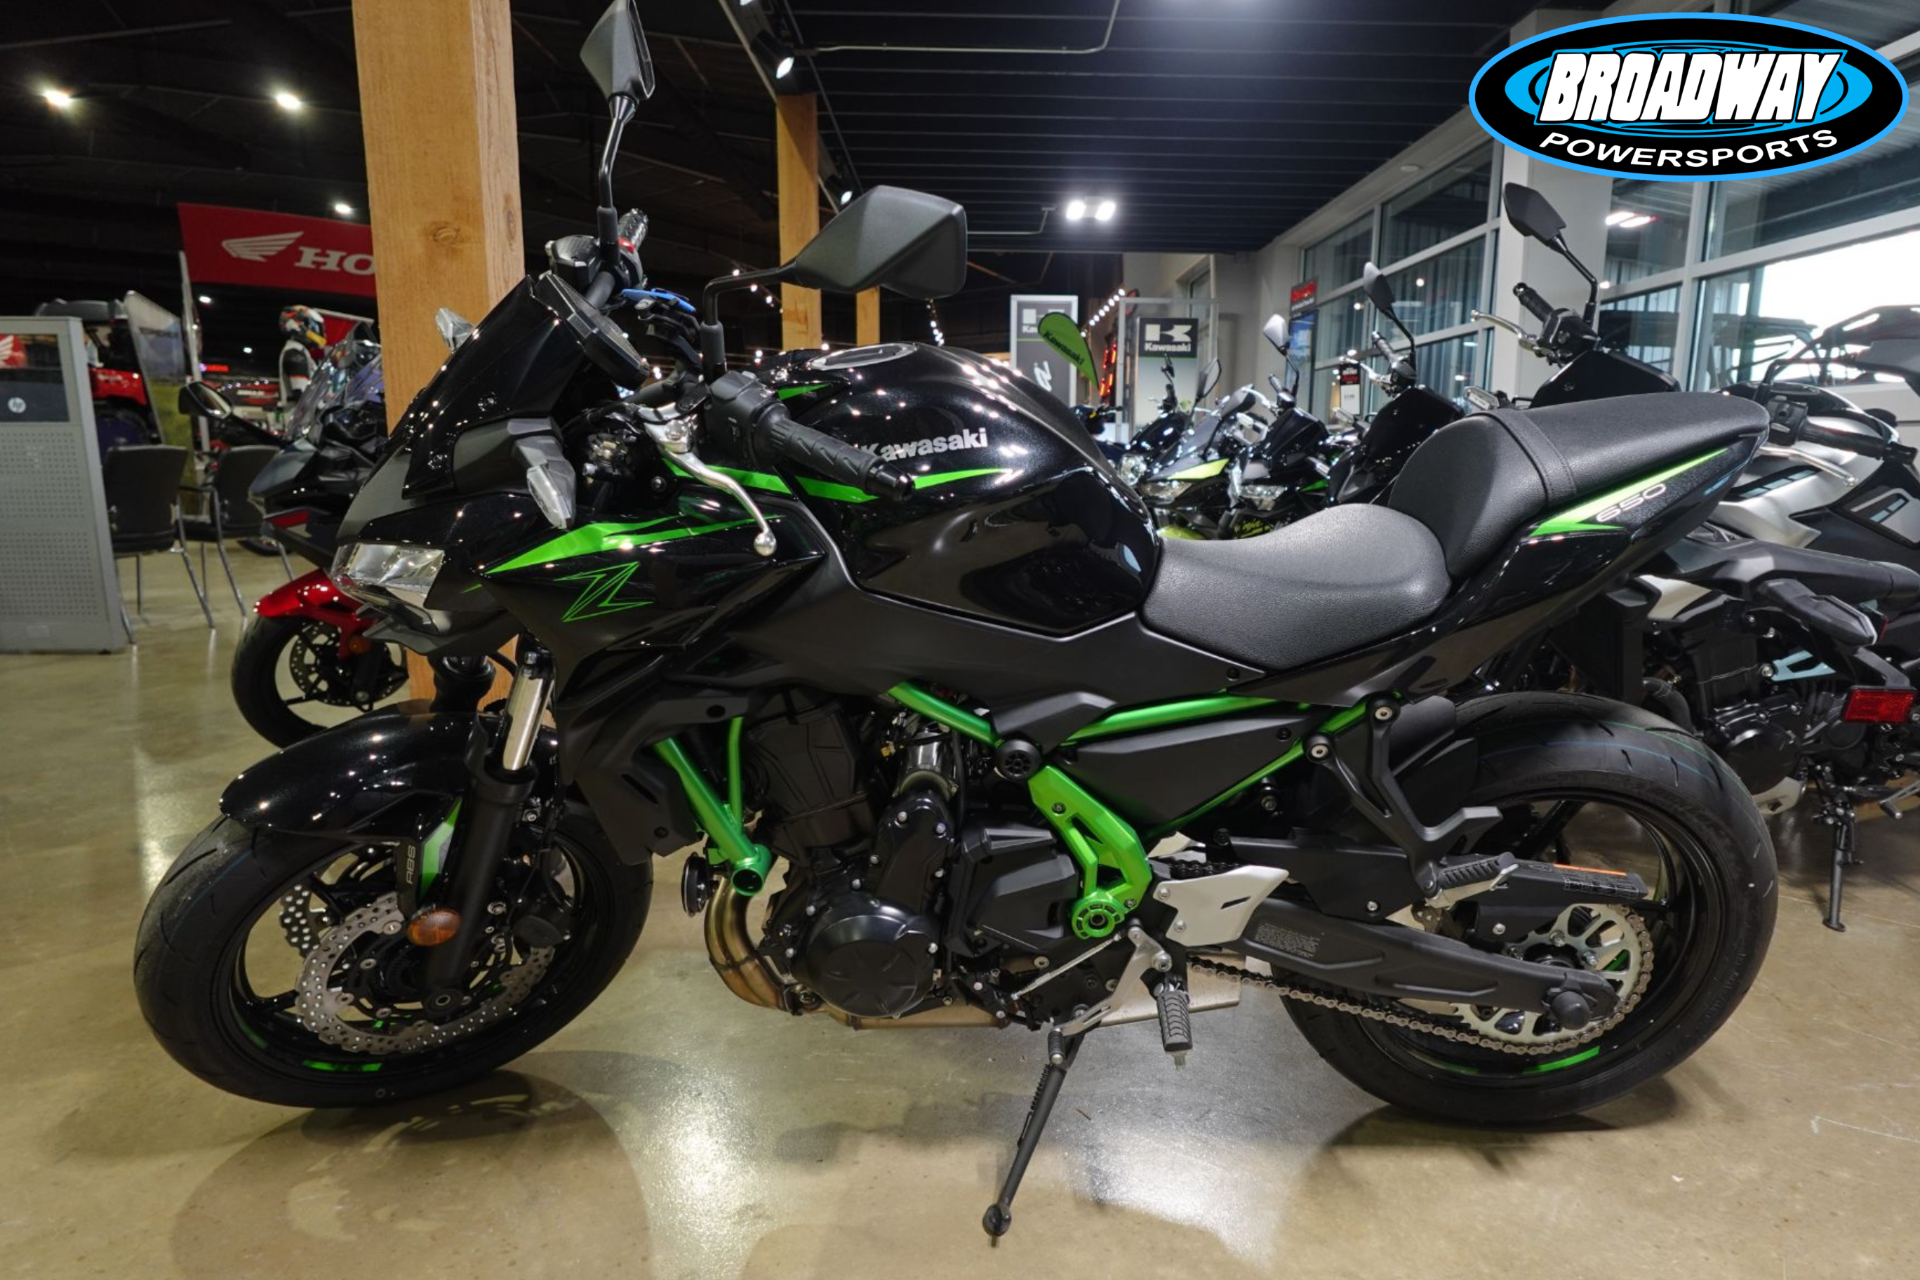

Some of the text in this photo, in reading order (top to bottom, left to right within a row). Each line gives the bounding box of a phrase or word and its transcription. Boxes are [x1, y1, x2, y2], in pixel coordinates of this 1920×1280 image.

[1144, 342, 1191, 352] Kawasaki
[1596, 483, 1667, 522] 650
[406, 845, 416, 884] ABS
